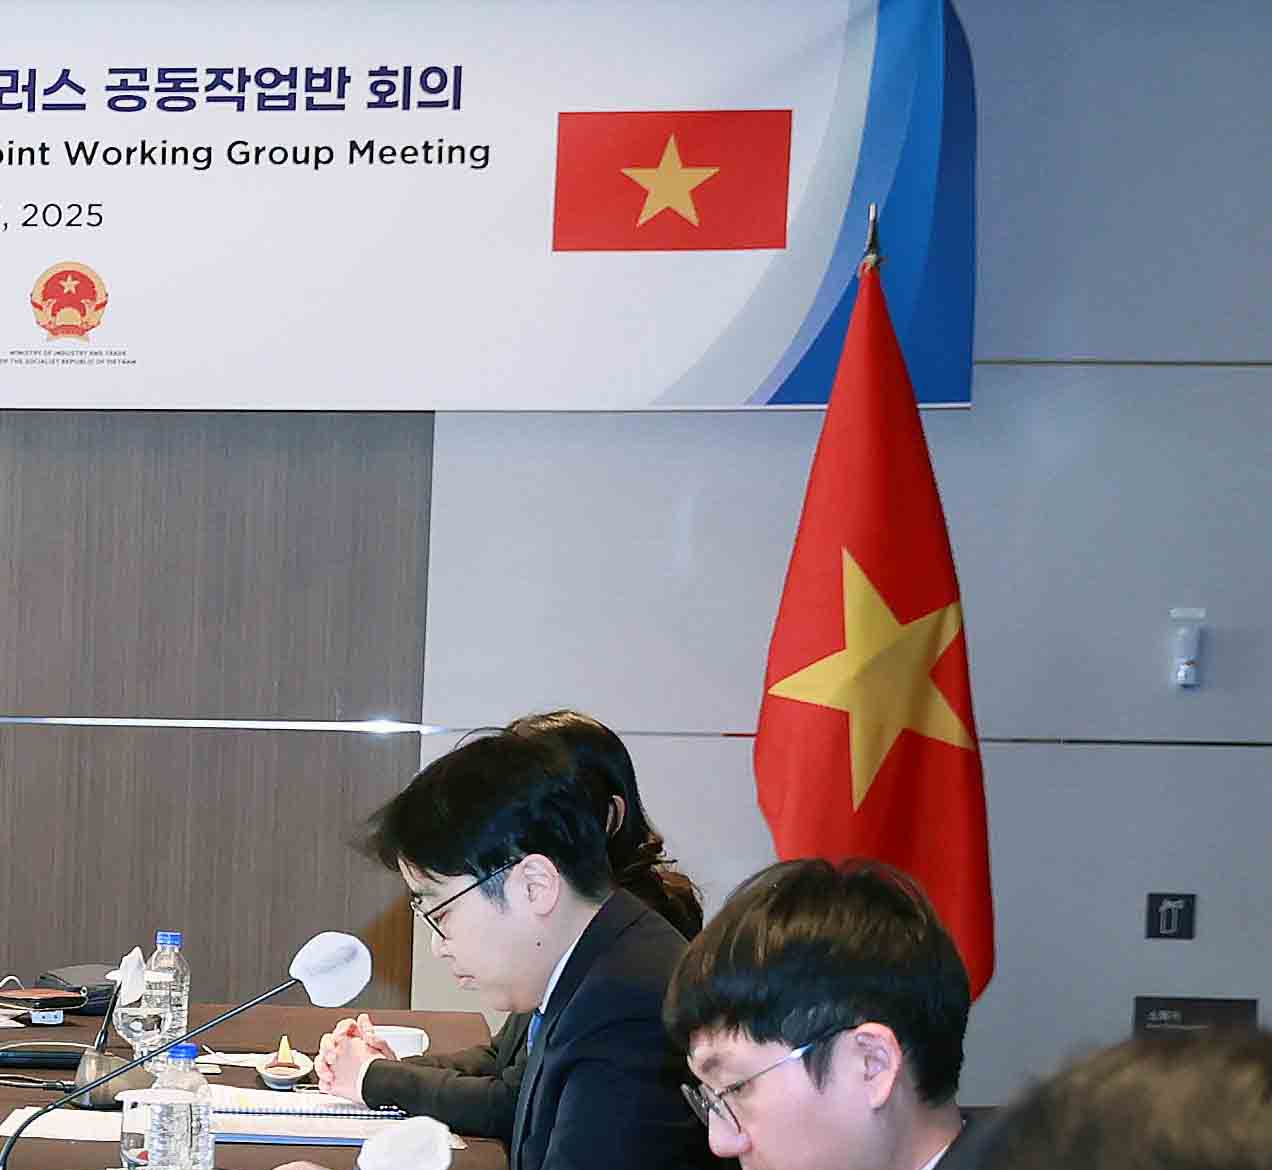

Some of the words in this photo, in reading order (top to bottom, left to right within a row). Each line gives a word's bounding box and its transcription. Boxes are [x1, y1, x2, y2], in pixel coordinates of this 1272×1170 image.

[104, 64, 352, 113] 공동작업반
[365, 63, 464, 112] 회의
[63, 139, 213, 171] Working
[226, 140, 334, 171] Group
[348, 138, 490, 170] Meeting
[21, 203, 103, 228] 2025
